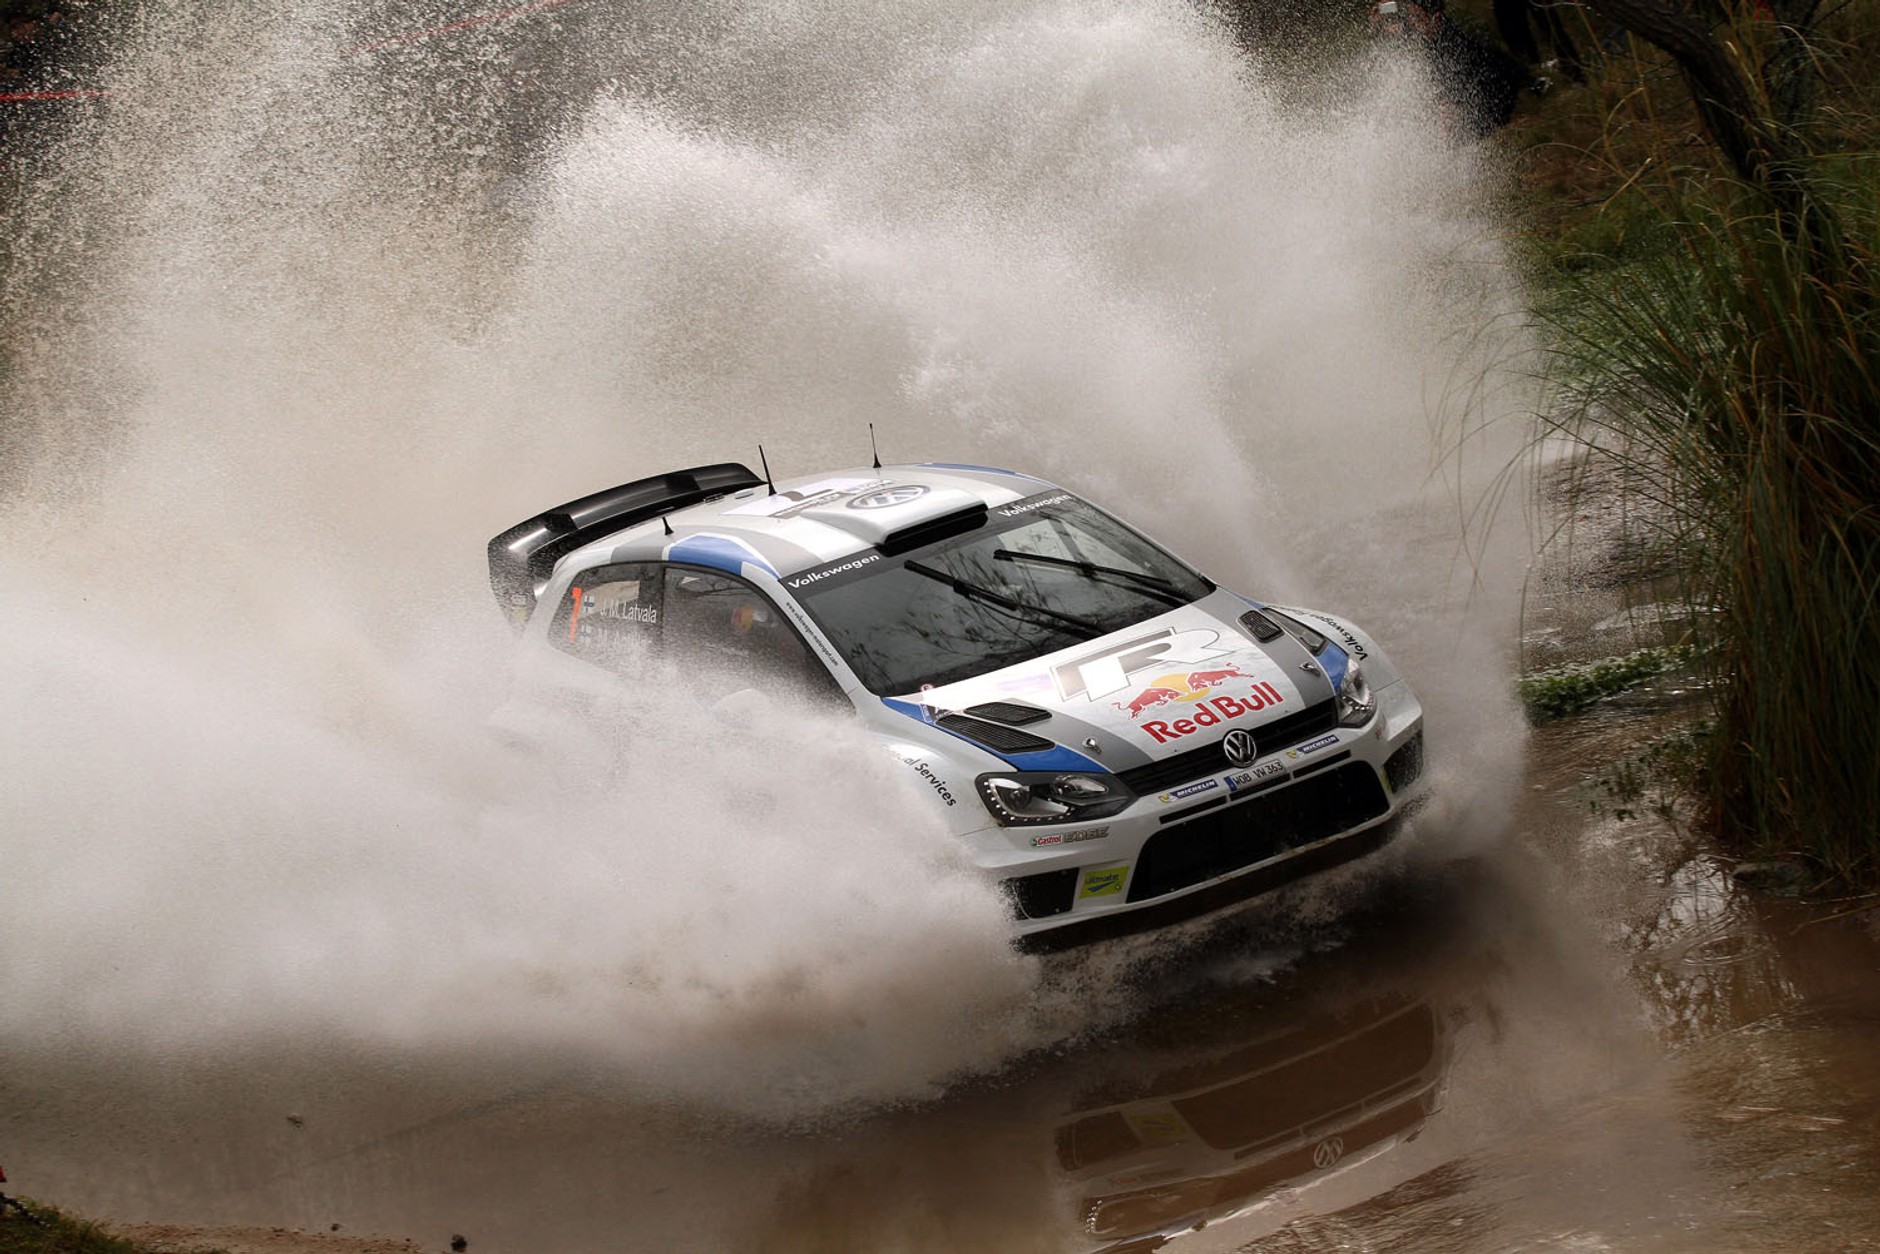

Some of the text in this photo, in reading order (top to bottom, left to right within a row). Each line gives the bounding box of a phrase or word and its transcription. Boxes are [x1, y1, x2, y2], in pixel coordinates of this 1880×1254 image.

[998, 494, 1072, 517] Volkswagen
[788, 554, 880, 588] Volkswagen
[623, 601, 657, 623] Latvala
[1141, 681, 1284, 744] Red Bull
[1302, 736, 1336, 752] MICHELIN
[914, 762, 957, 807] Services
[1233, 761, 1284, 786] WOB VW 363
[1177, 780, 1216, 798] MICHELIN
[1037, 826, 1110, 846] Castrol EDGE
